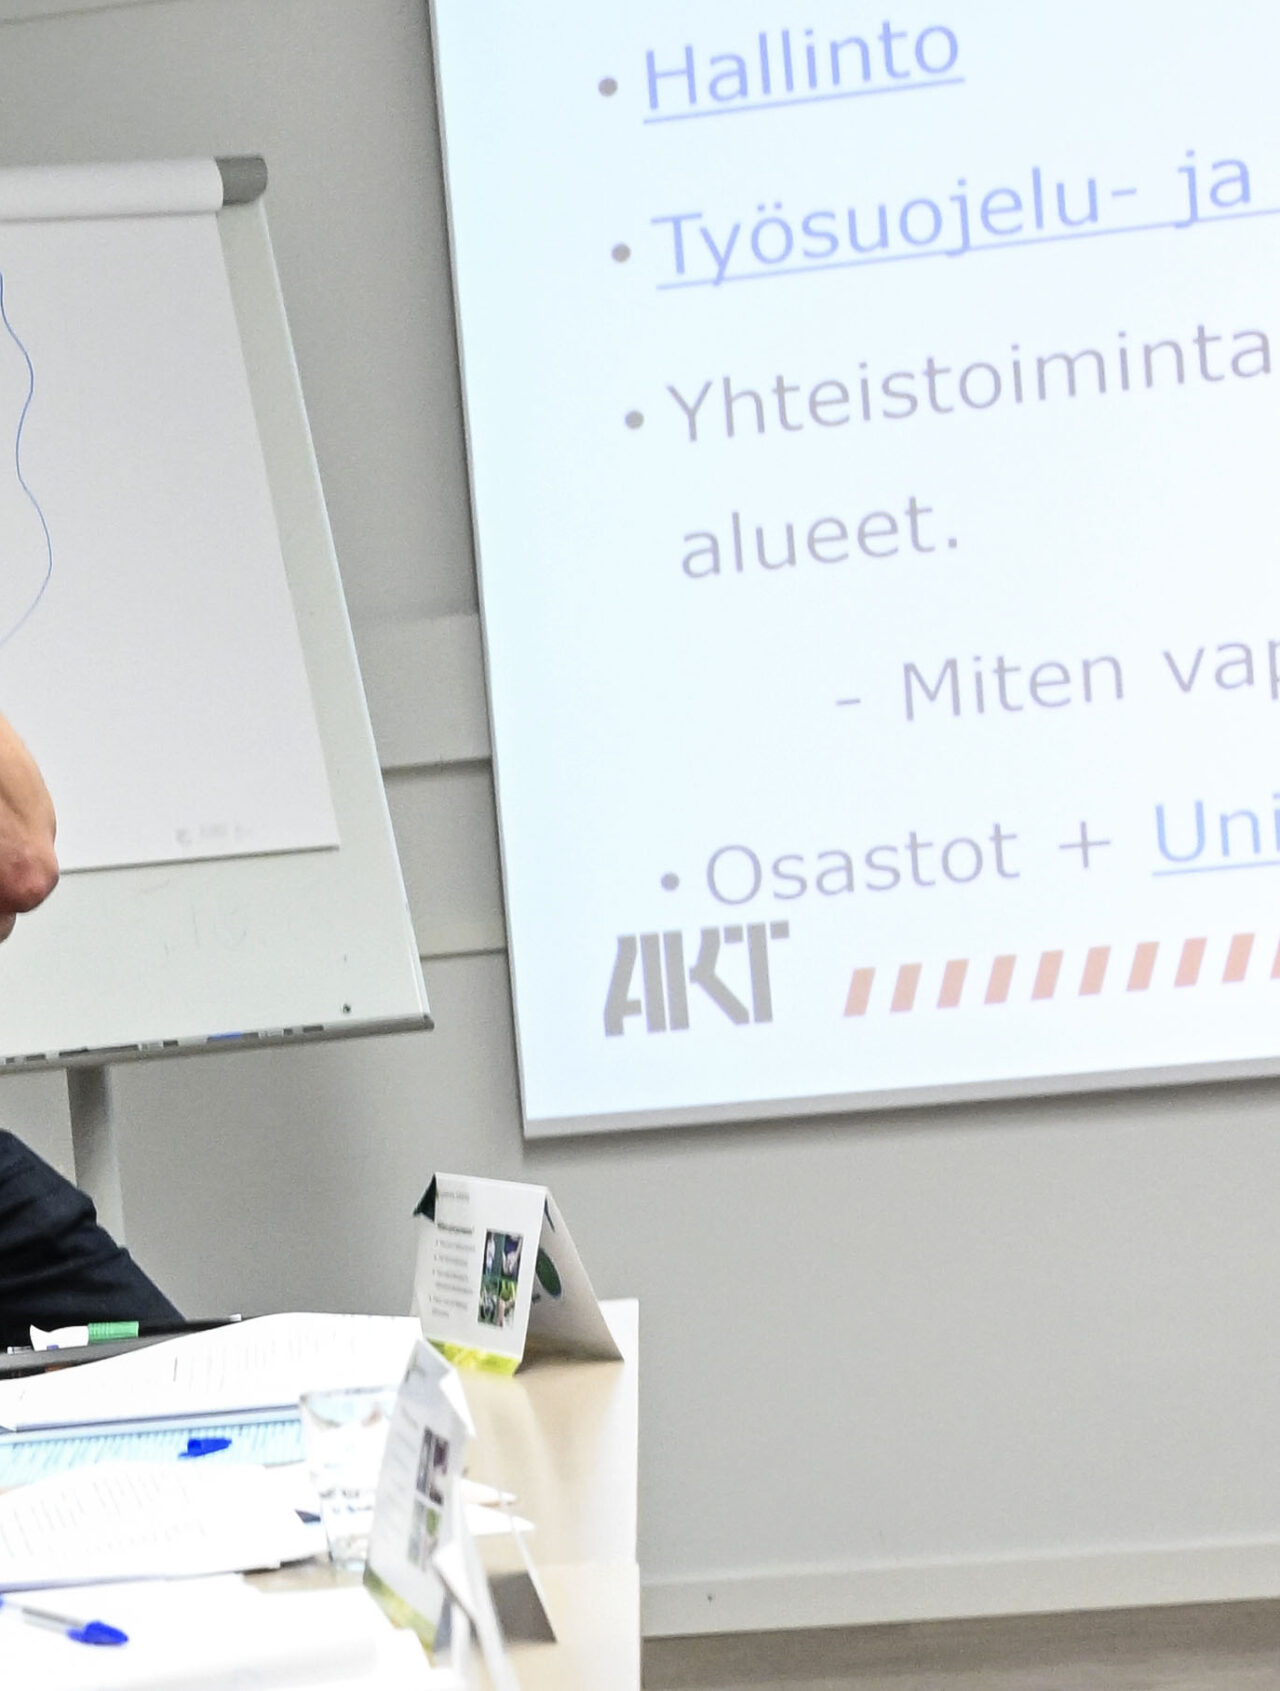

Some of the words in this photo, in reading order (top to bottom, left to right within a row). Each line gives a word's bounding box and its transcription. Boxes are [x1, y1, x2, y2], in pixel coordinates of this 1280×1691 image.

[644, 20, 960, 112] Hallinto
[650, 165, 1138, 286] Työsuojelu-
[1170, 148, 1252, 230] ja
[665, 323, 1272, 443] Yhteistoiminta
[681, 495, 959, 580] alueet.
[902, 655, 1125, 722] Miten
[705, 822, 1021, 907] Osastot
[602, 919, 791, 1039] AKT
